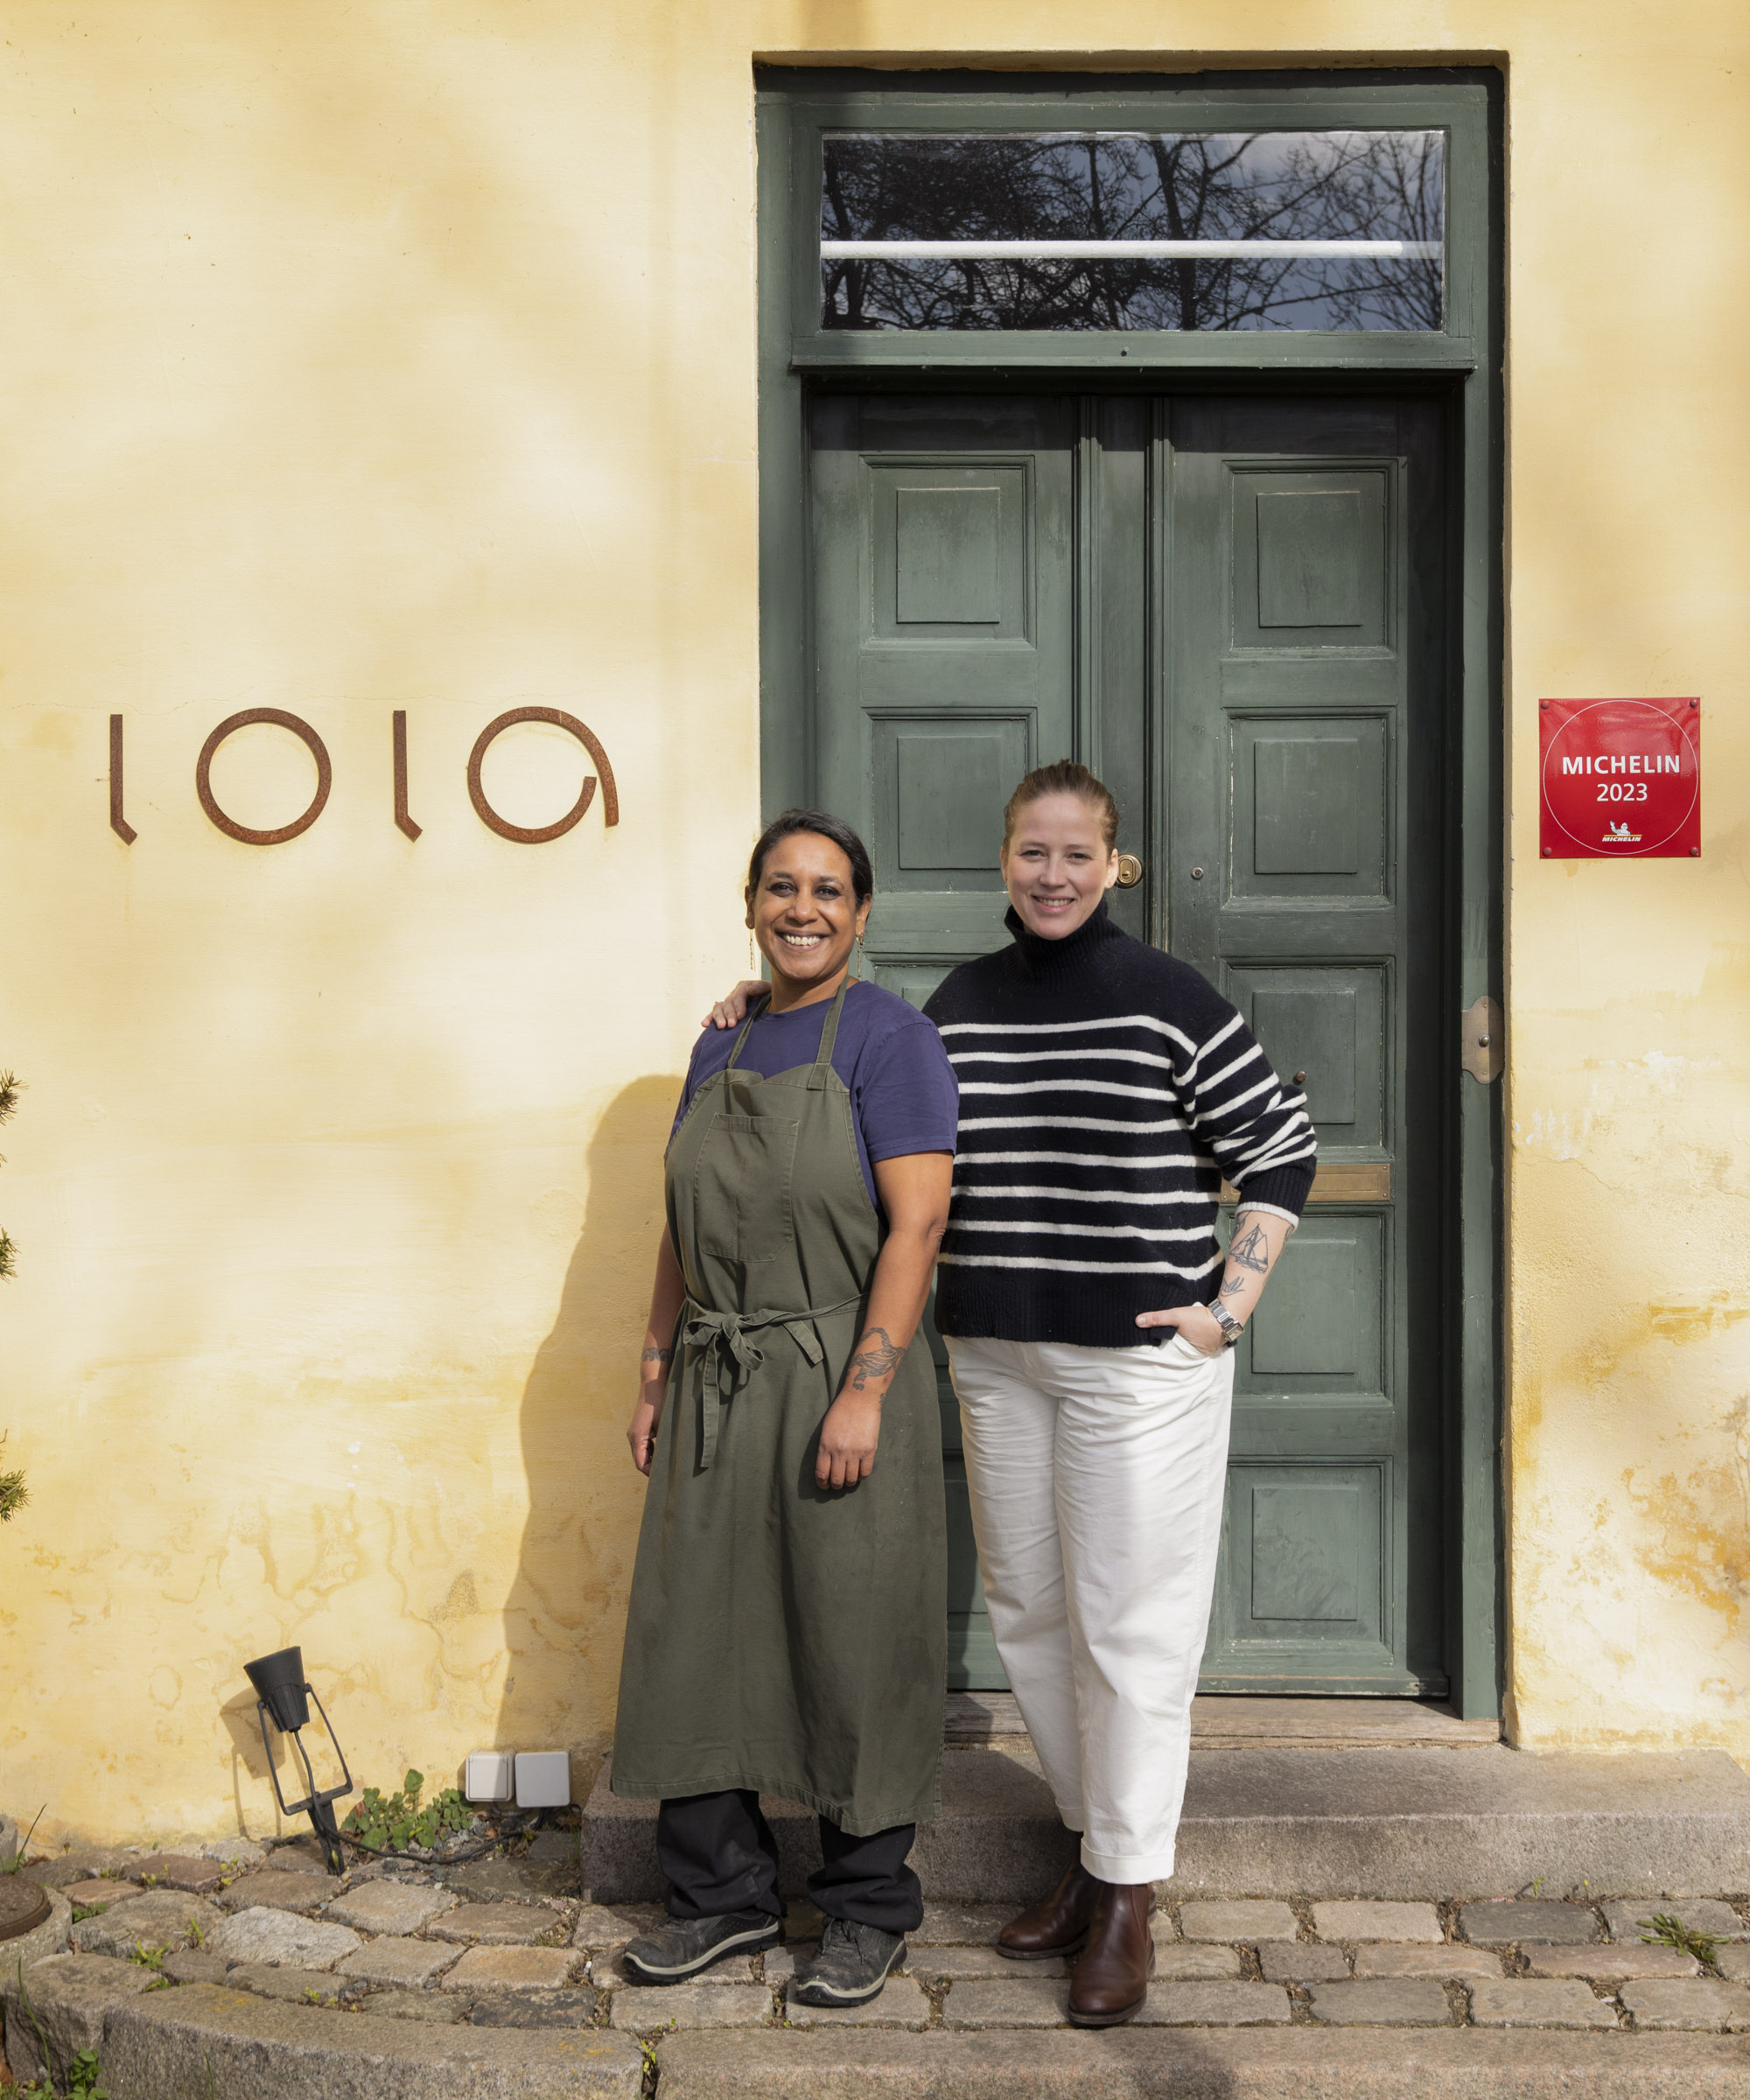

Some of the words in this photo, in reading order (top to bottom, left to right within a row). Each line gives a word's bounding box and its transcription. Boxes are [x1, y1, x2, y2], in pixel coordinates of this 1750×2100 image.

[1563, 755, 1680, 774] MICHELIN
[109, 706, 620, 845] lola
[1597, 783, 1648, 802] 2023
